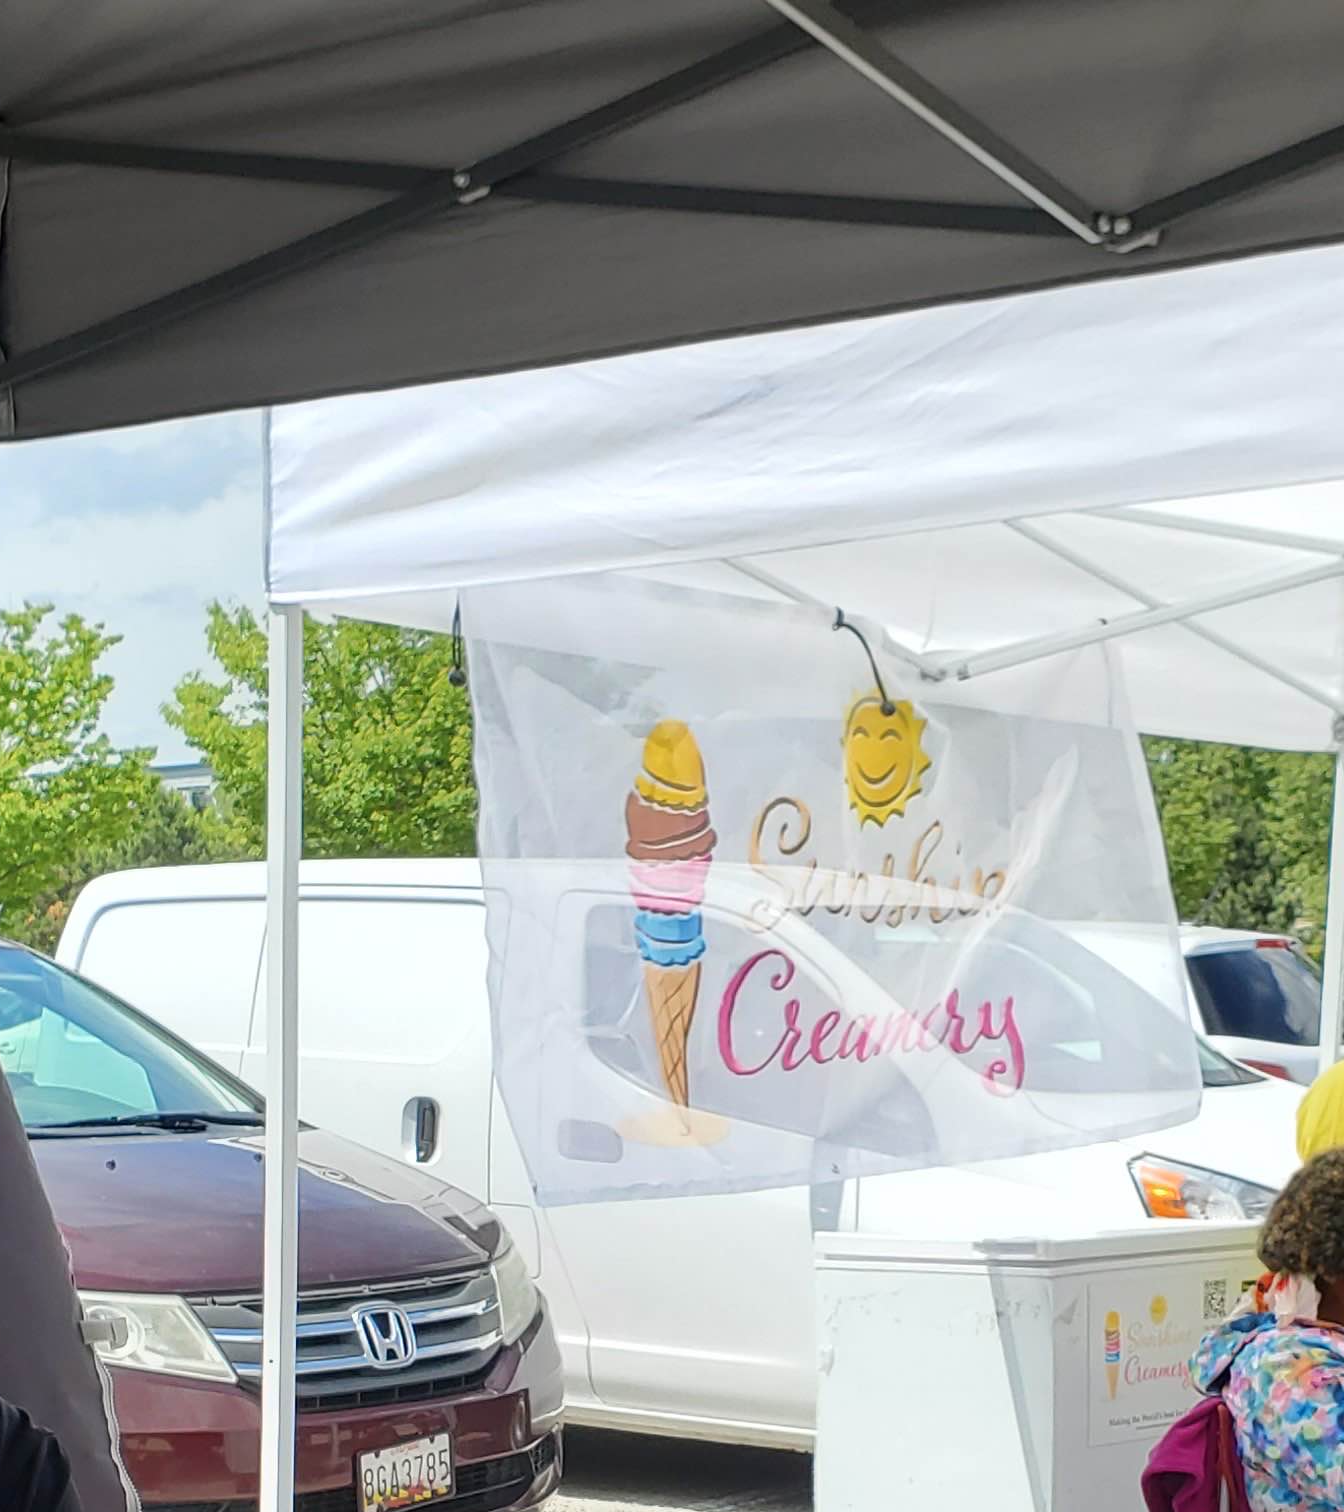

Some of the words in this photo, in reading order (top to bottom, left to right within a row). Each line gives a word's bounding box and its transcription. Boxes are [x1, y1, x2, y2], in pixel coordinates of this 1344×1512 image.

[740, 797, 1010, 934] Sunshin
[717, 949, 1025, 1098] Creamery
[1125, 1355, 1191, 1388] Creamery
[364, 1449, 449, 1506] 8GA3785
